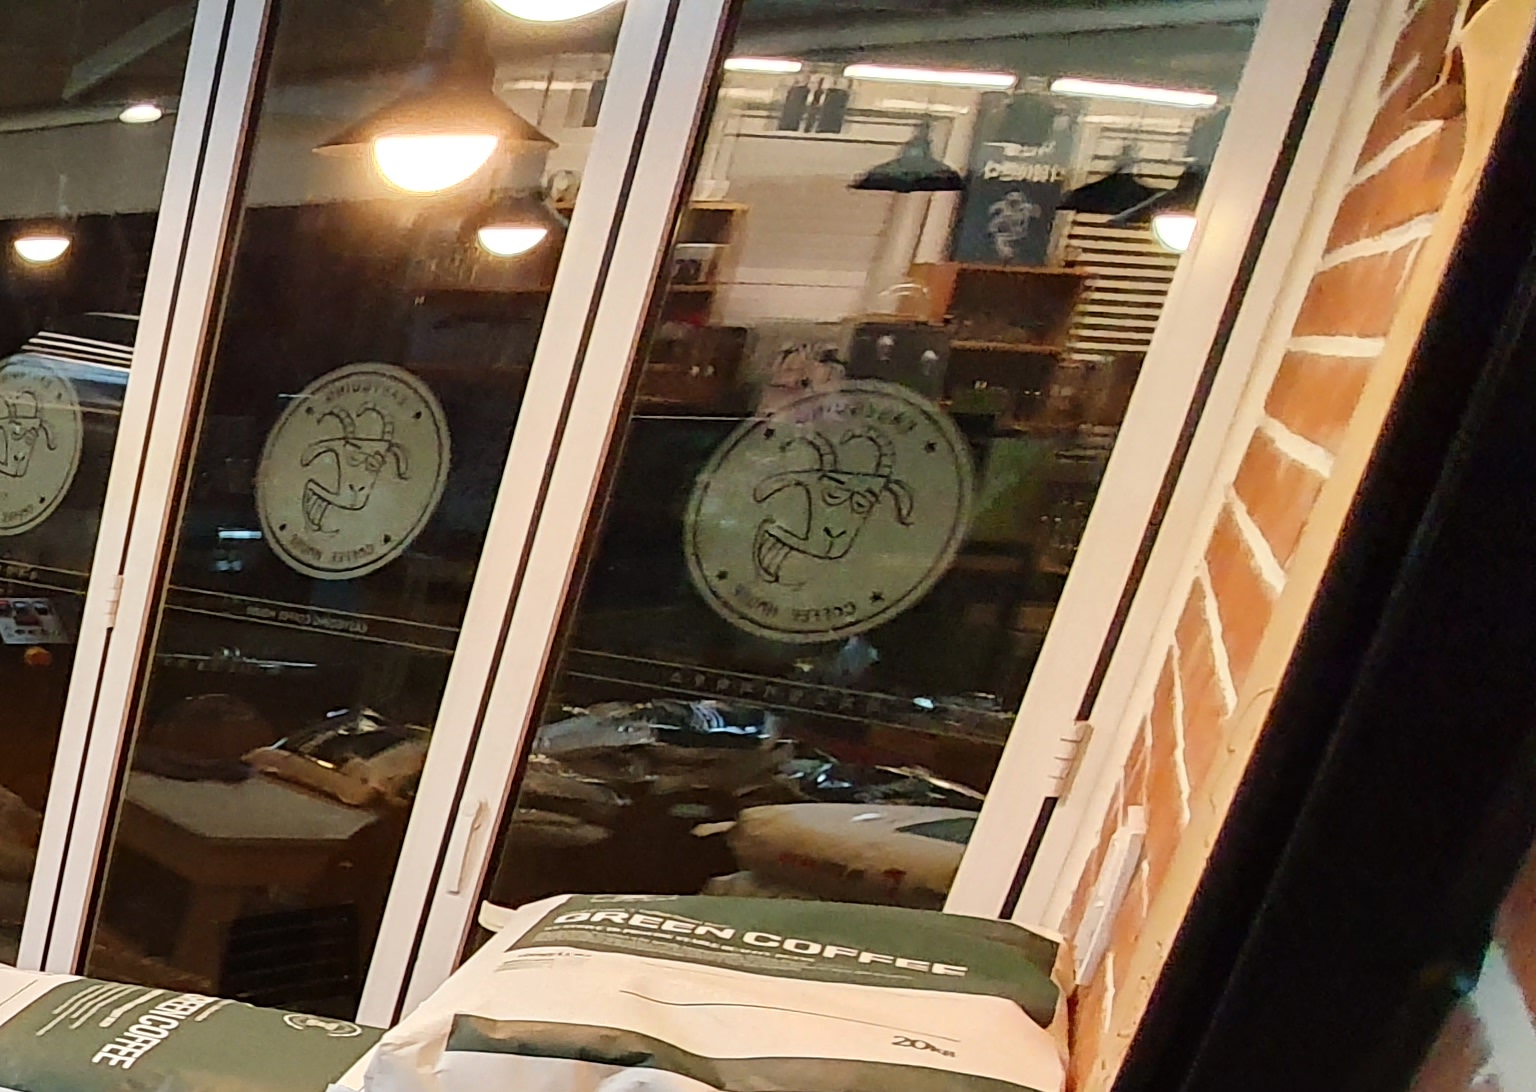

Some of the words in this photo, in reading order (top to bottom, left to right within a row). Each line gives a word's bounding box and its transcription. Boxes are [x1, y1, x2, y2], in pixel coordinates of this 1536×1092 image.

[554, 911, 736, 940] GREEN
[742, 931, 969, 977] COFFEE
[92, 1012, 179, 1070] COFFEE
